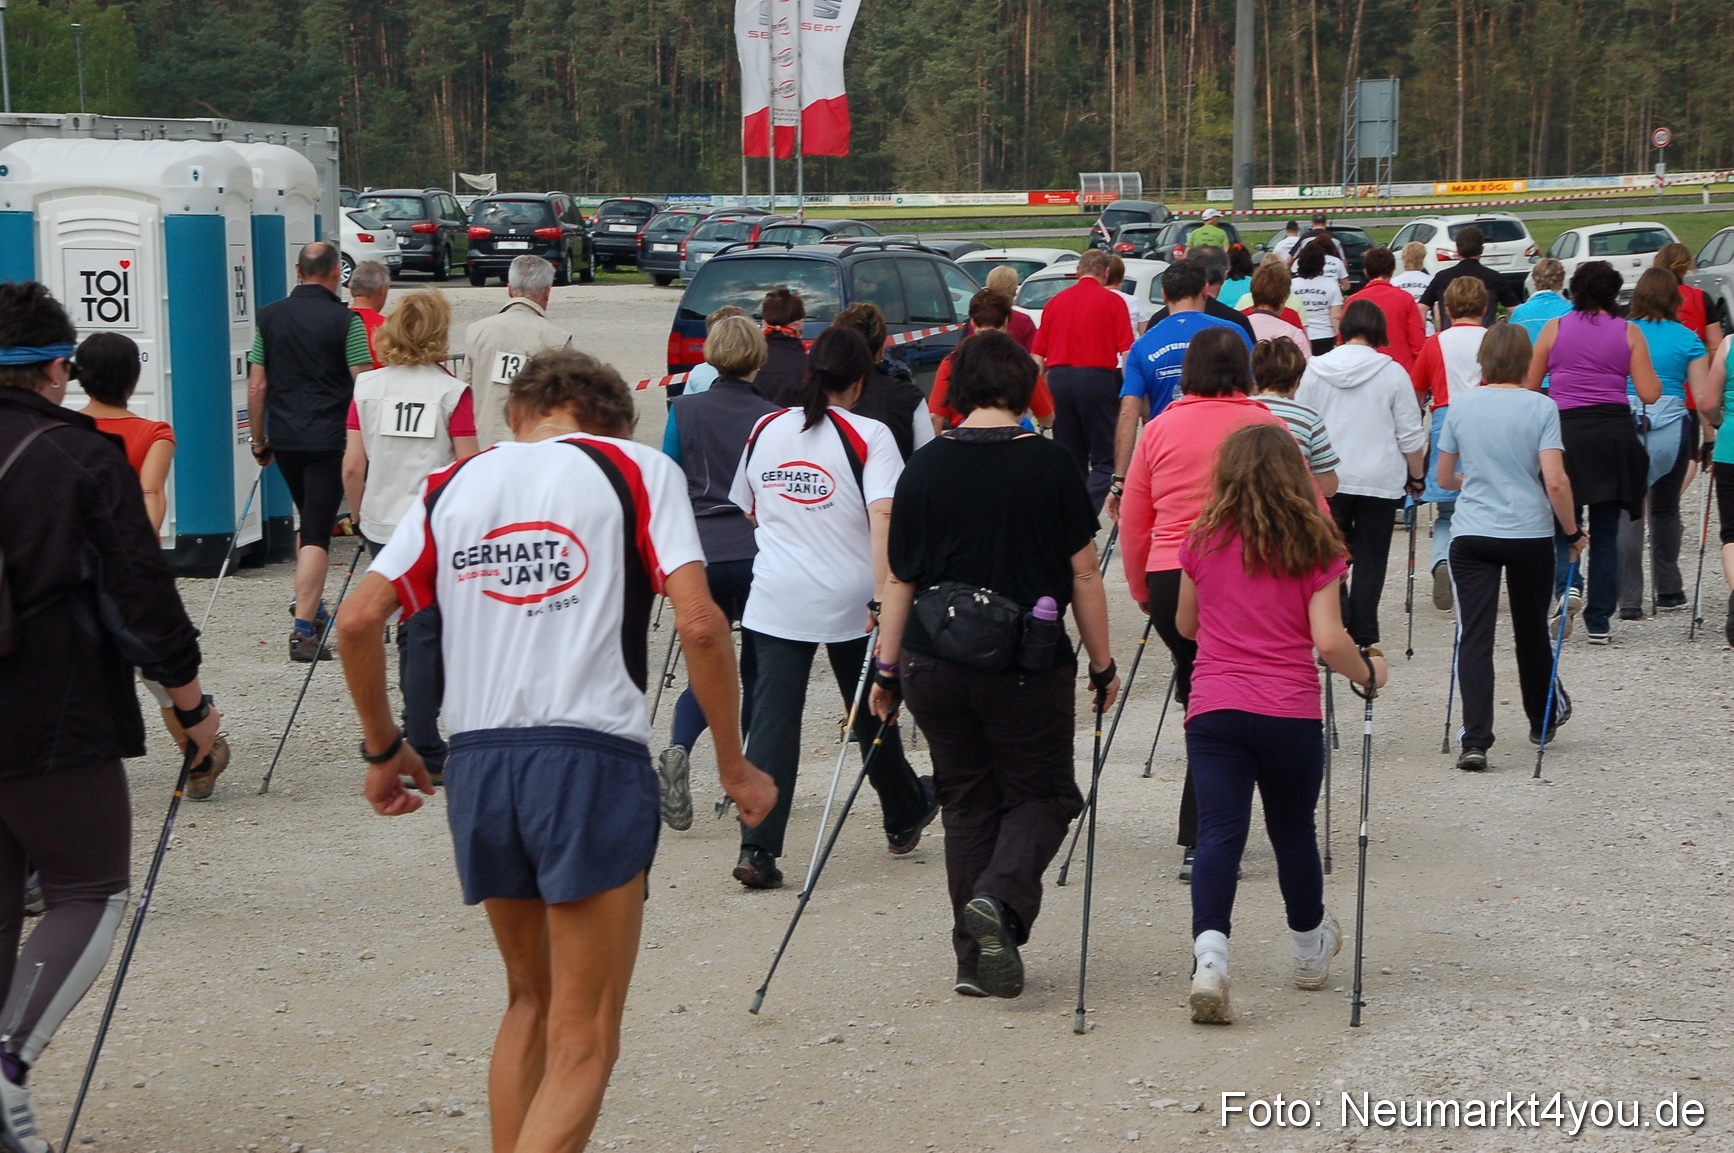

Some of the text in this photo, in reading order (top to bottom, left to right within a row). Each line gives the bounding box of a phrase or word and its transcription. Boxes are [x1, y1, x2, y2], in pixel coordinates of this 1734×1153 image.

[748, 30, 770, 39] SE
[801, 22, 842, 32] SEAT
[80, 270, 129, 296] TOI
[81, 297, 130, 322] TOI
[1148, 342, 1191, 362] funrun
[501, 355, 520, 380] 13
[395, 402, 425, 432] 117
[761, 470, 819, 483] GERHART
[786, 483, 828, 495] JANIG
[452, 541, 560, 569] GERHART
